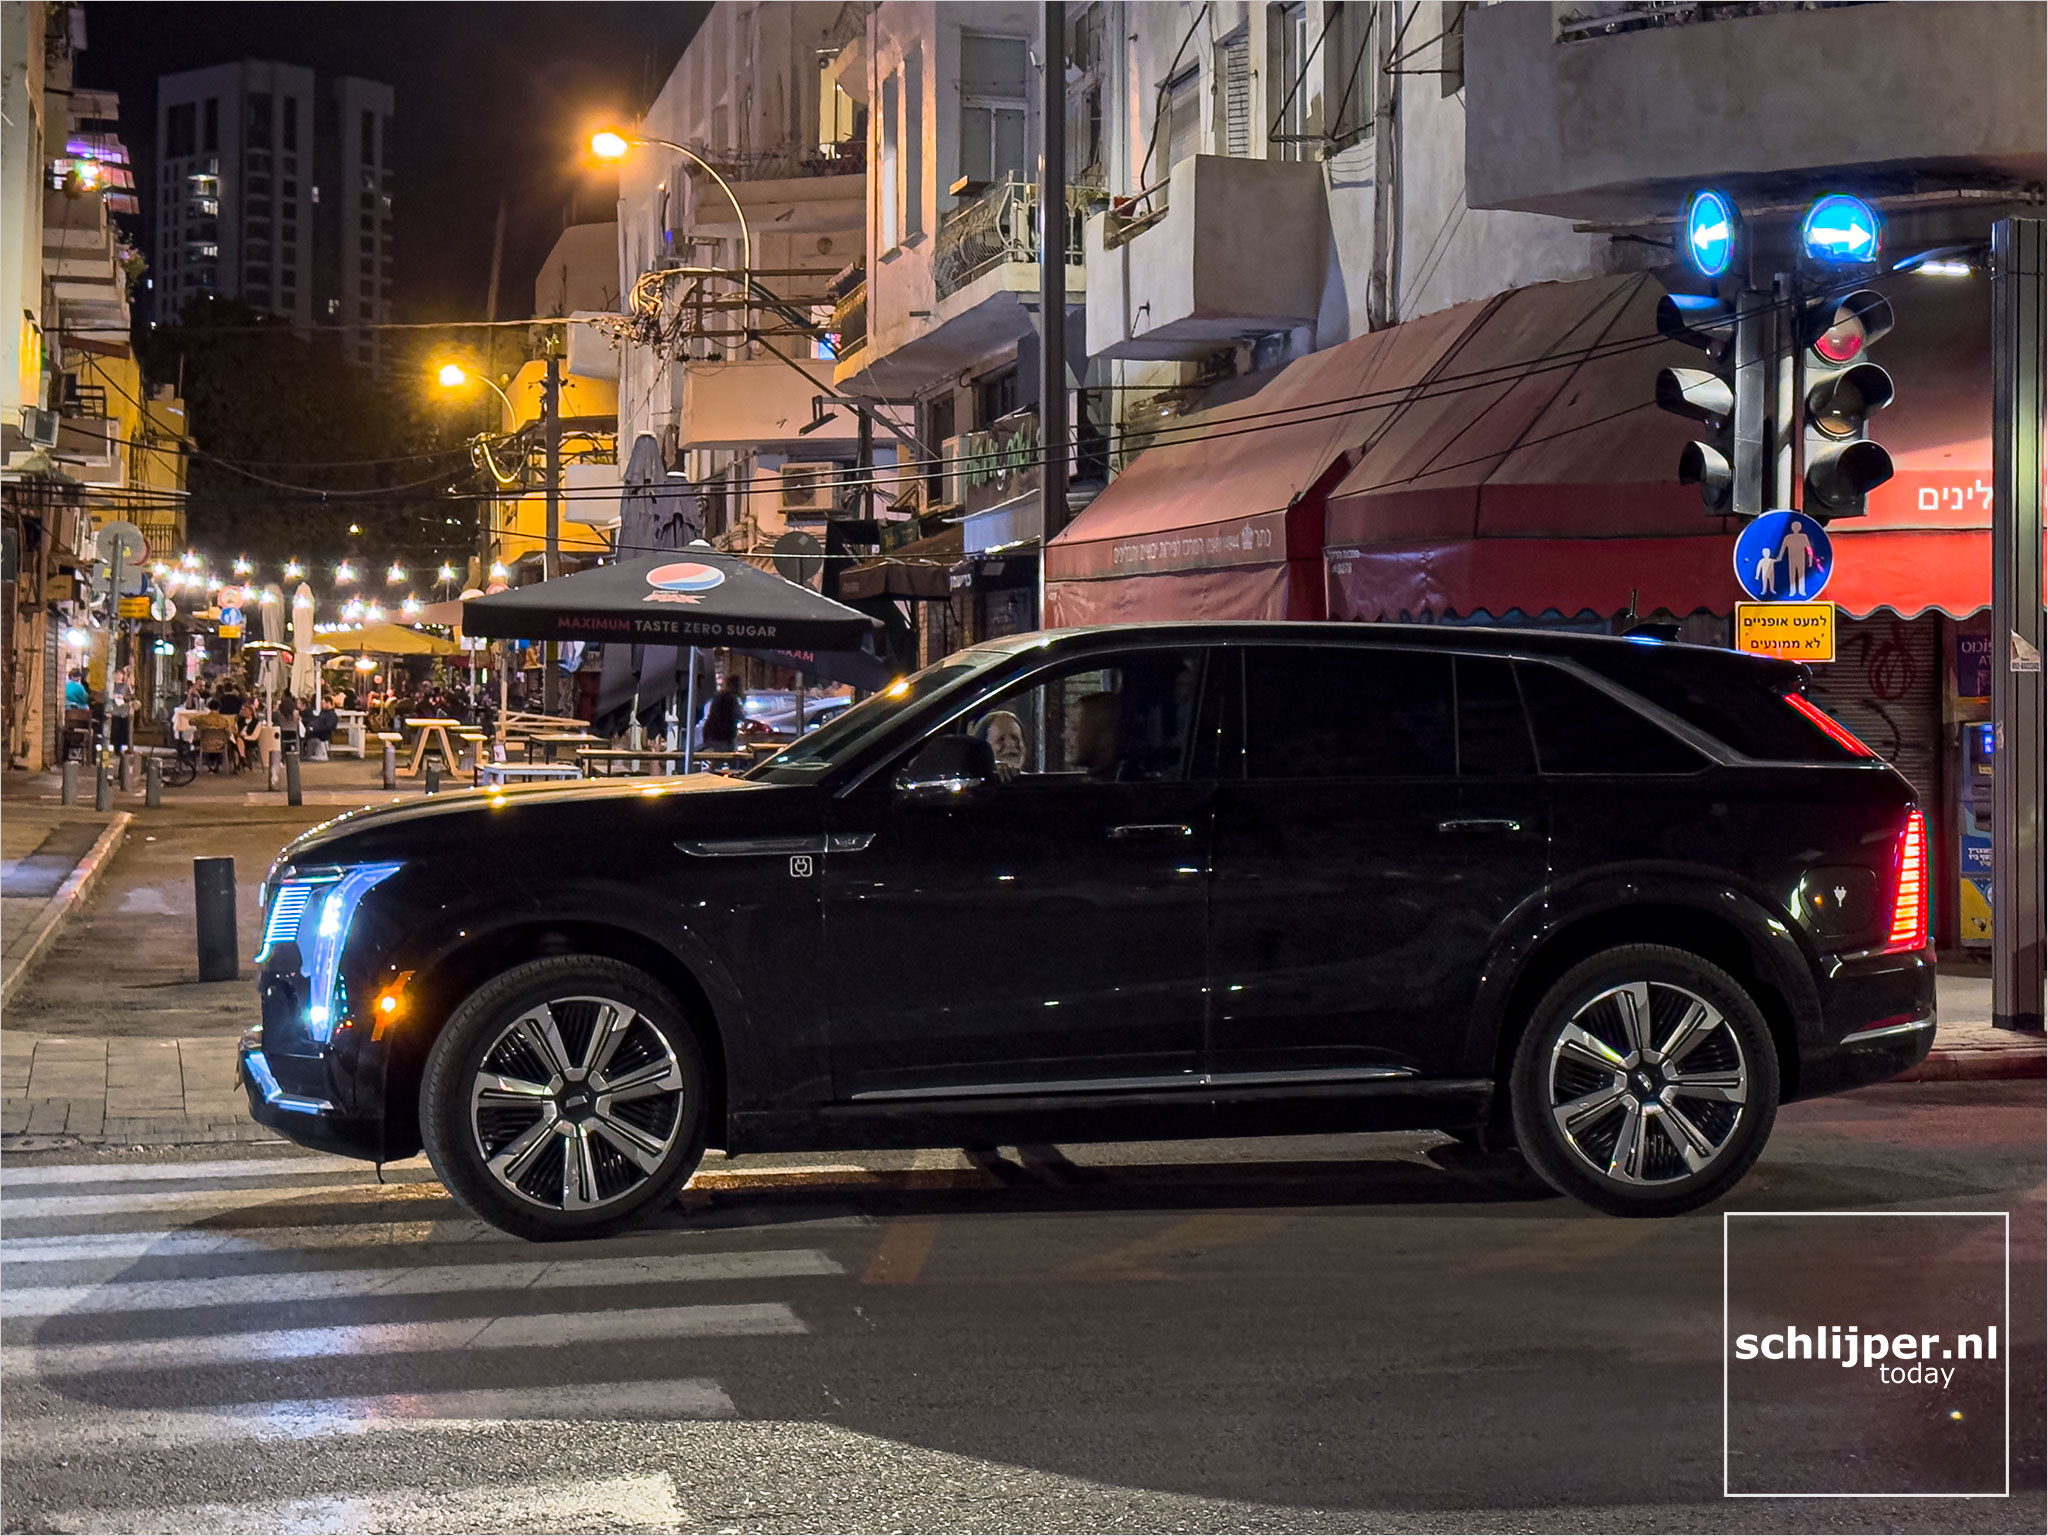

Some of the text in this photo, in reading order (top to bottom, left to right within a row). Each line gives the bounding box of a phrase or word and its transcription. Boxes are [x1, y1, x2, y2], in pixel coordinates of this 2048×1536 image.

[557, 617, 776, 637] MAXIMUM TASTE ZERO SUGAR
[1744, 615, 1827, 627] למעט אופניים
[1750, 637, 1820, 649] לא ממונעים
